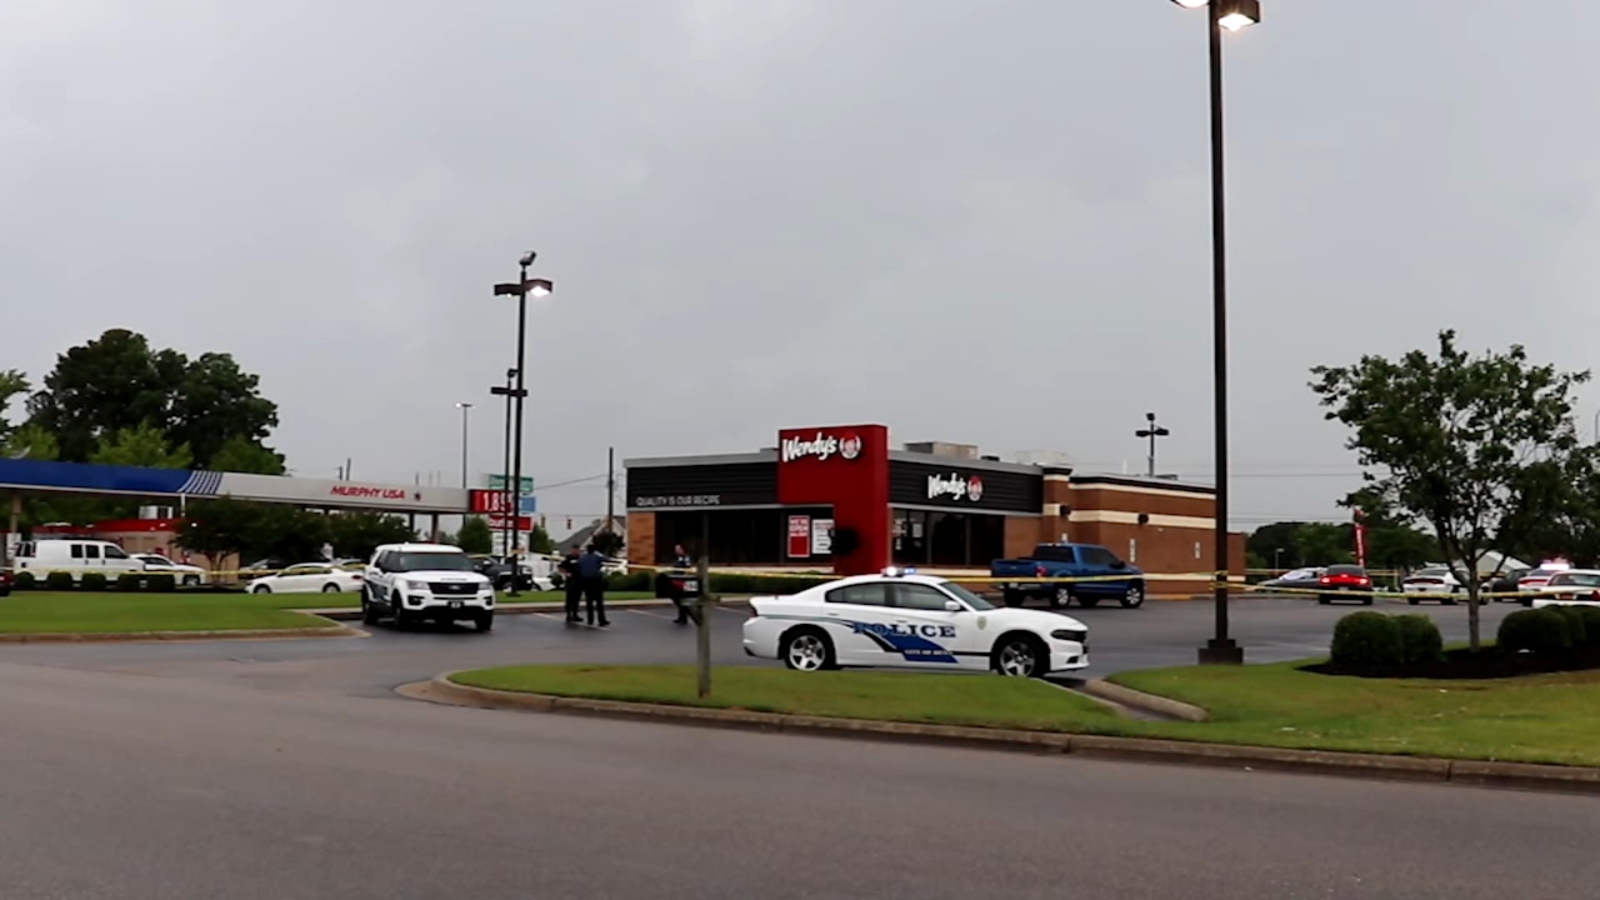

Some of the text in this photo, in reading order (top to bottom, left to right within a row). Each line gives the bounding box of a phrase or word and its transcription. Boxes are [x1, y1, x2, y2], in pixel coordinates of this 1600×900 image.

[783, 432, 837, 462] Wendy's
[330, 486, 405, 499] MURPHY USA
[927, 472, 966, 500] Wendy's
[636, 494, 720, 507] QUALITY IS OUR RECIPE
[853, 623, 957, 638] POLICE
